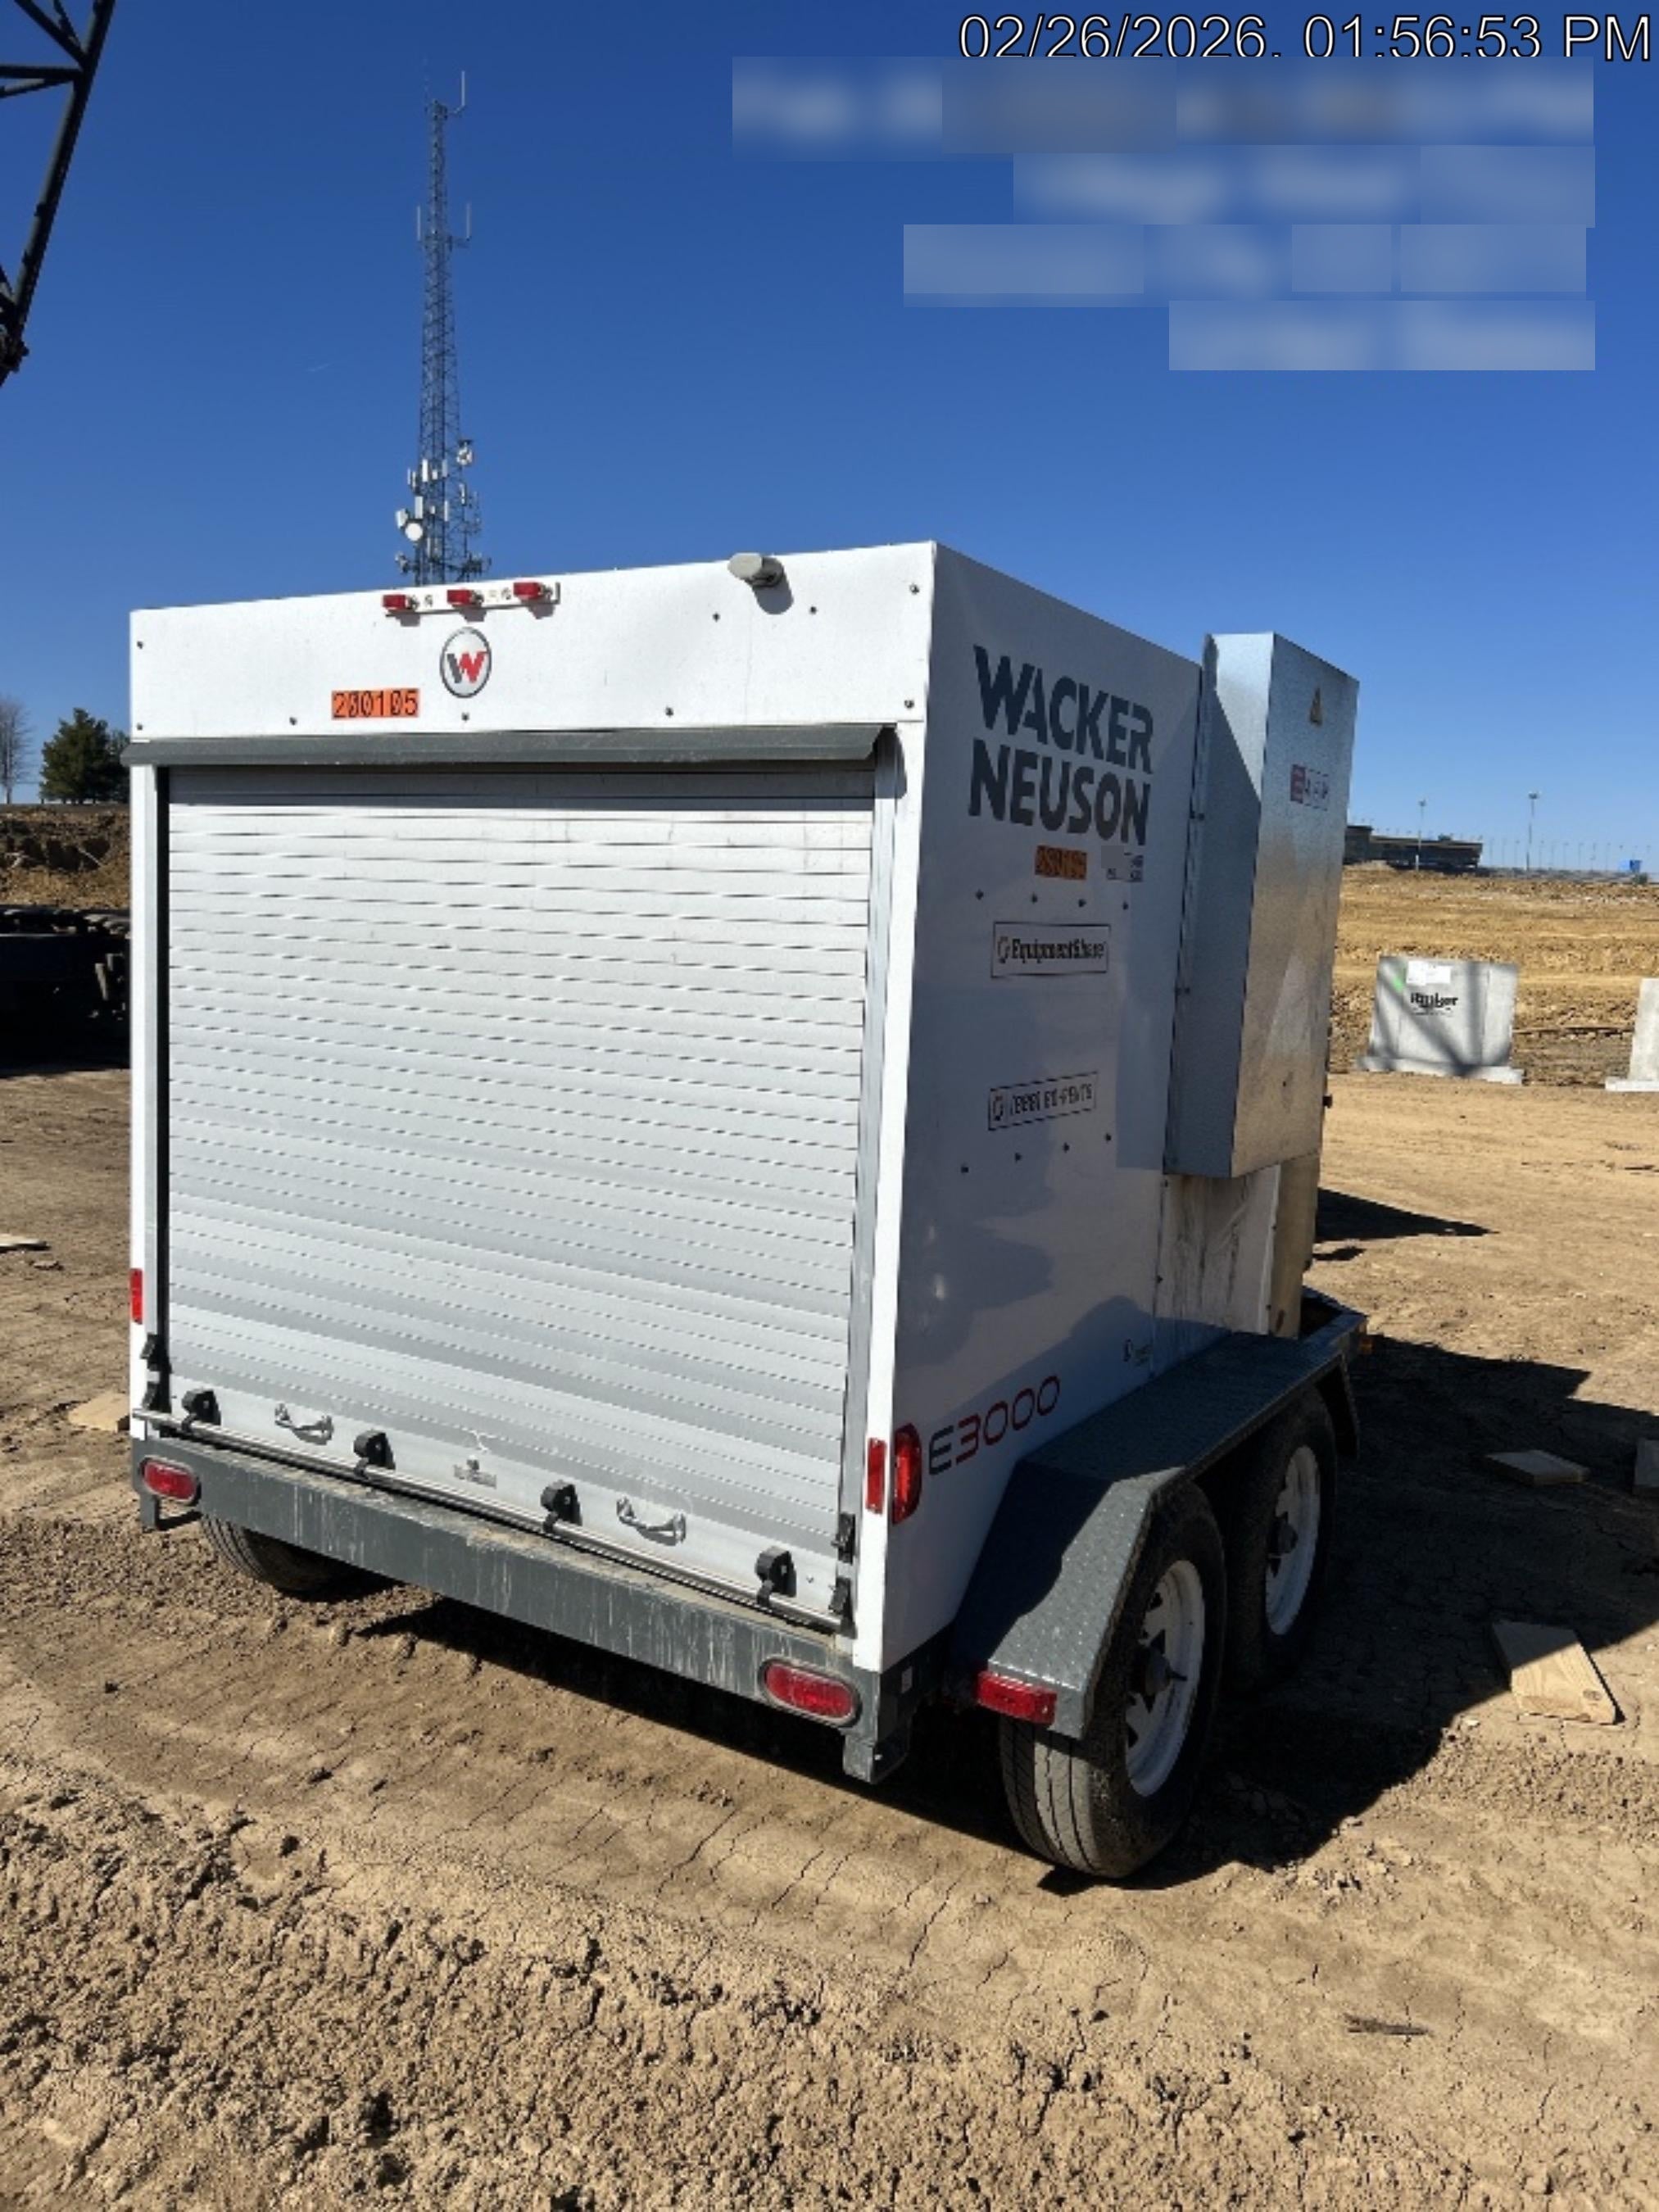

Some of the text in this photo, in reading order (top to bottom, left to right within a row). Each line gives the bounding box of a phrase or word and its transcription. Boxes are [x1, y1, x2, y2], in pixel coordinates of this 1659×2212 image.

[333, 690, 419, 718] 200105
[973, 644, 1154, 774] WACKER
[968, 739, 1150, 845] NEUSON
[929, 1376, 1060, 1474] E3000
